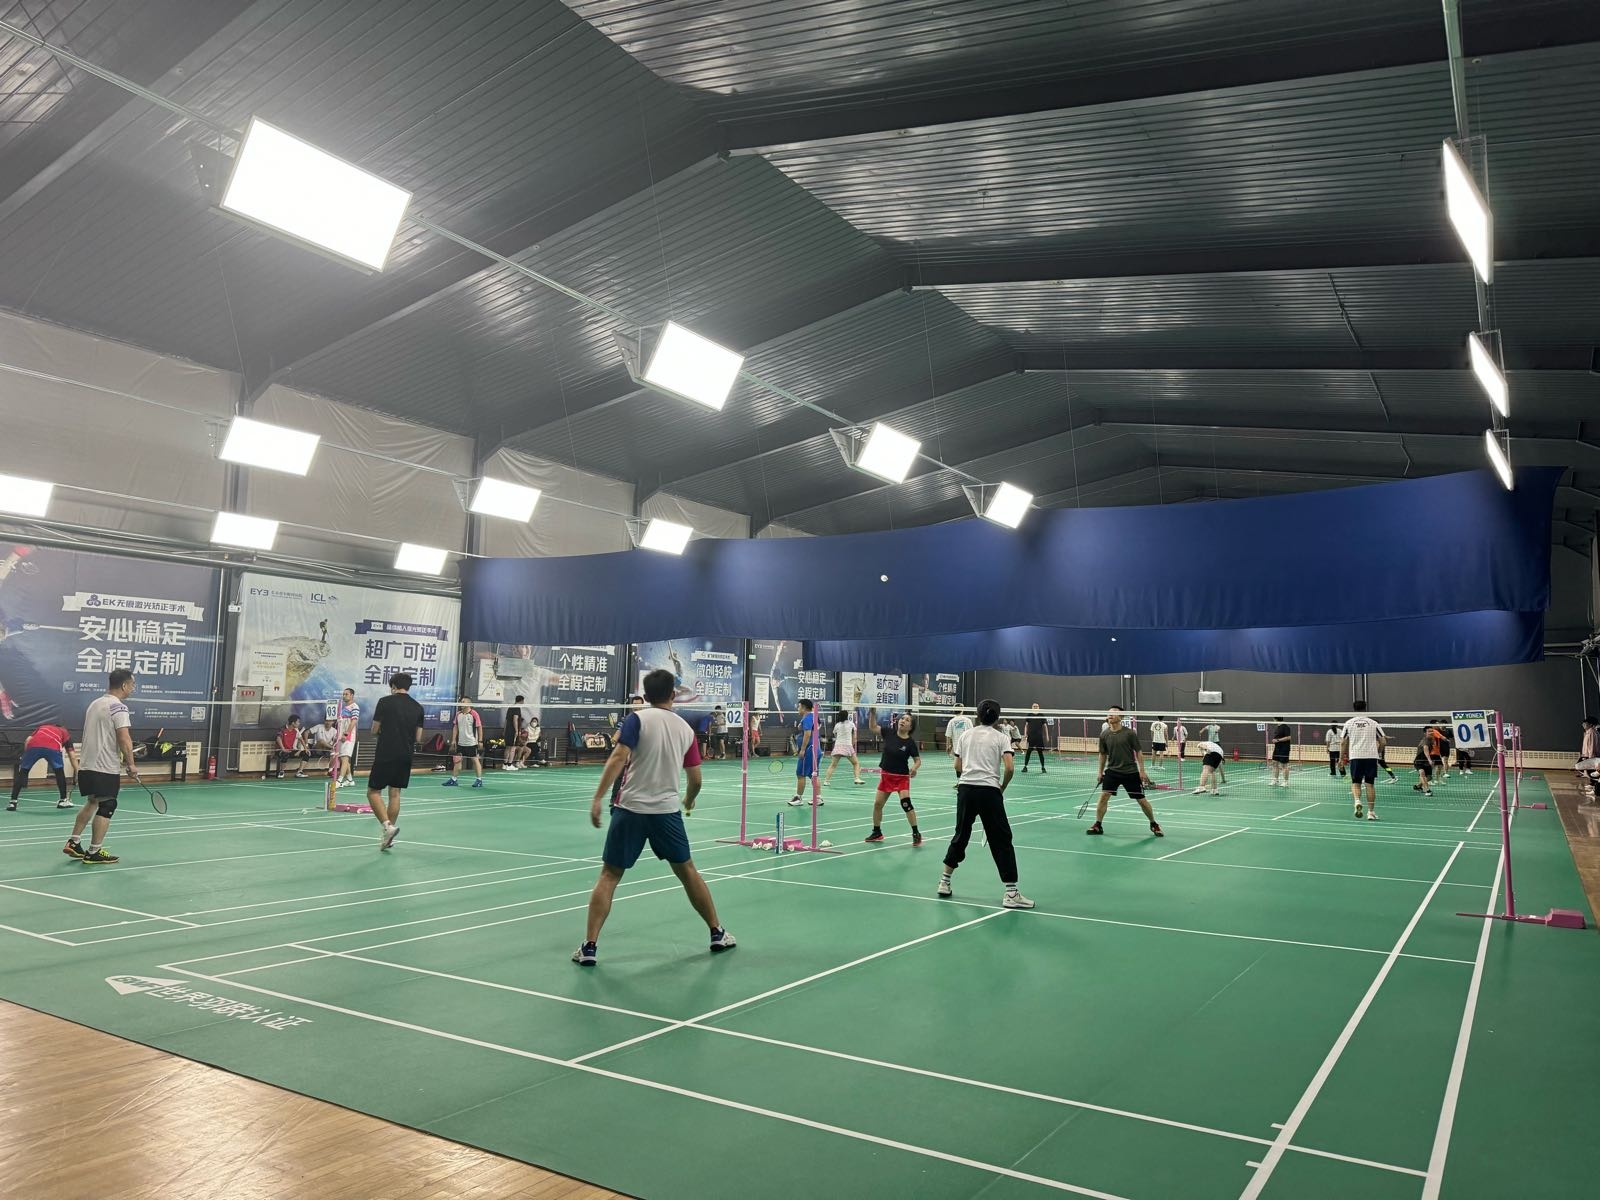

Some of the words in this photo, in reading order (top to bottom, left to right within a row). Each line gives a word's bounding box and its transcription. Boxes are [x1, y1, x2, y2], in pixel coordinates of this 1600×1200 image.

[310, 593, 326, 602] ICL
[78, 615, 187, 646] 安心稳定
[365, 639, 437, 663] 超广可逆
[75, 647, 185, 676] 全程定制
[559, 653, 608, 673] 个性精准
[363, 664, 436, 687] 全程定制
[557, 674, 607, 693] 全程定制
[797, 671, 827, 685] 安心稳定
[695, 681, 732, 697] 全程定制
[797, 687, 826, 700] 全程定制
[327, 706, 336, 717] 03
[727, 710, 741, 724] 02
[1457, 723, 1486, 743] 01
[145, 984, 314, 1031] 世界羽联认证
